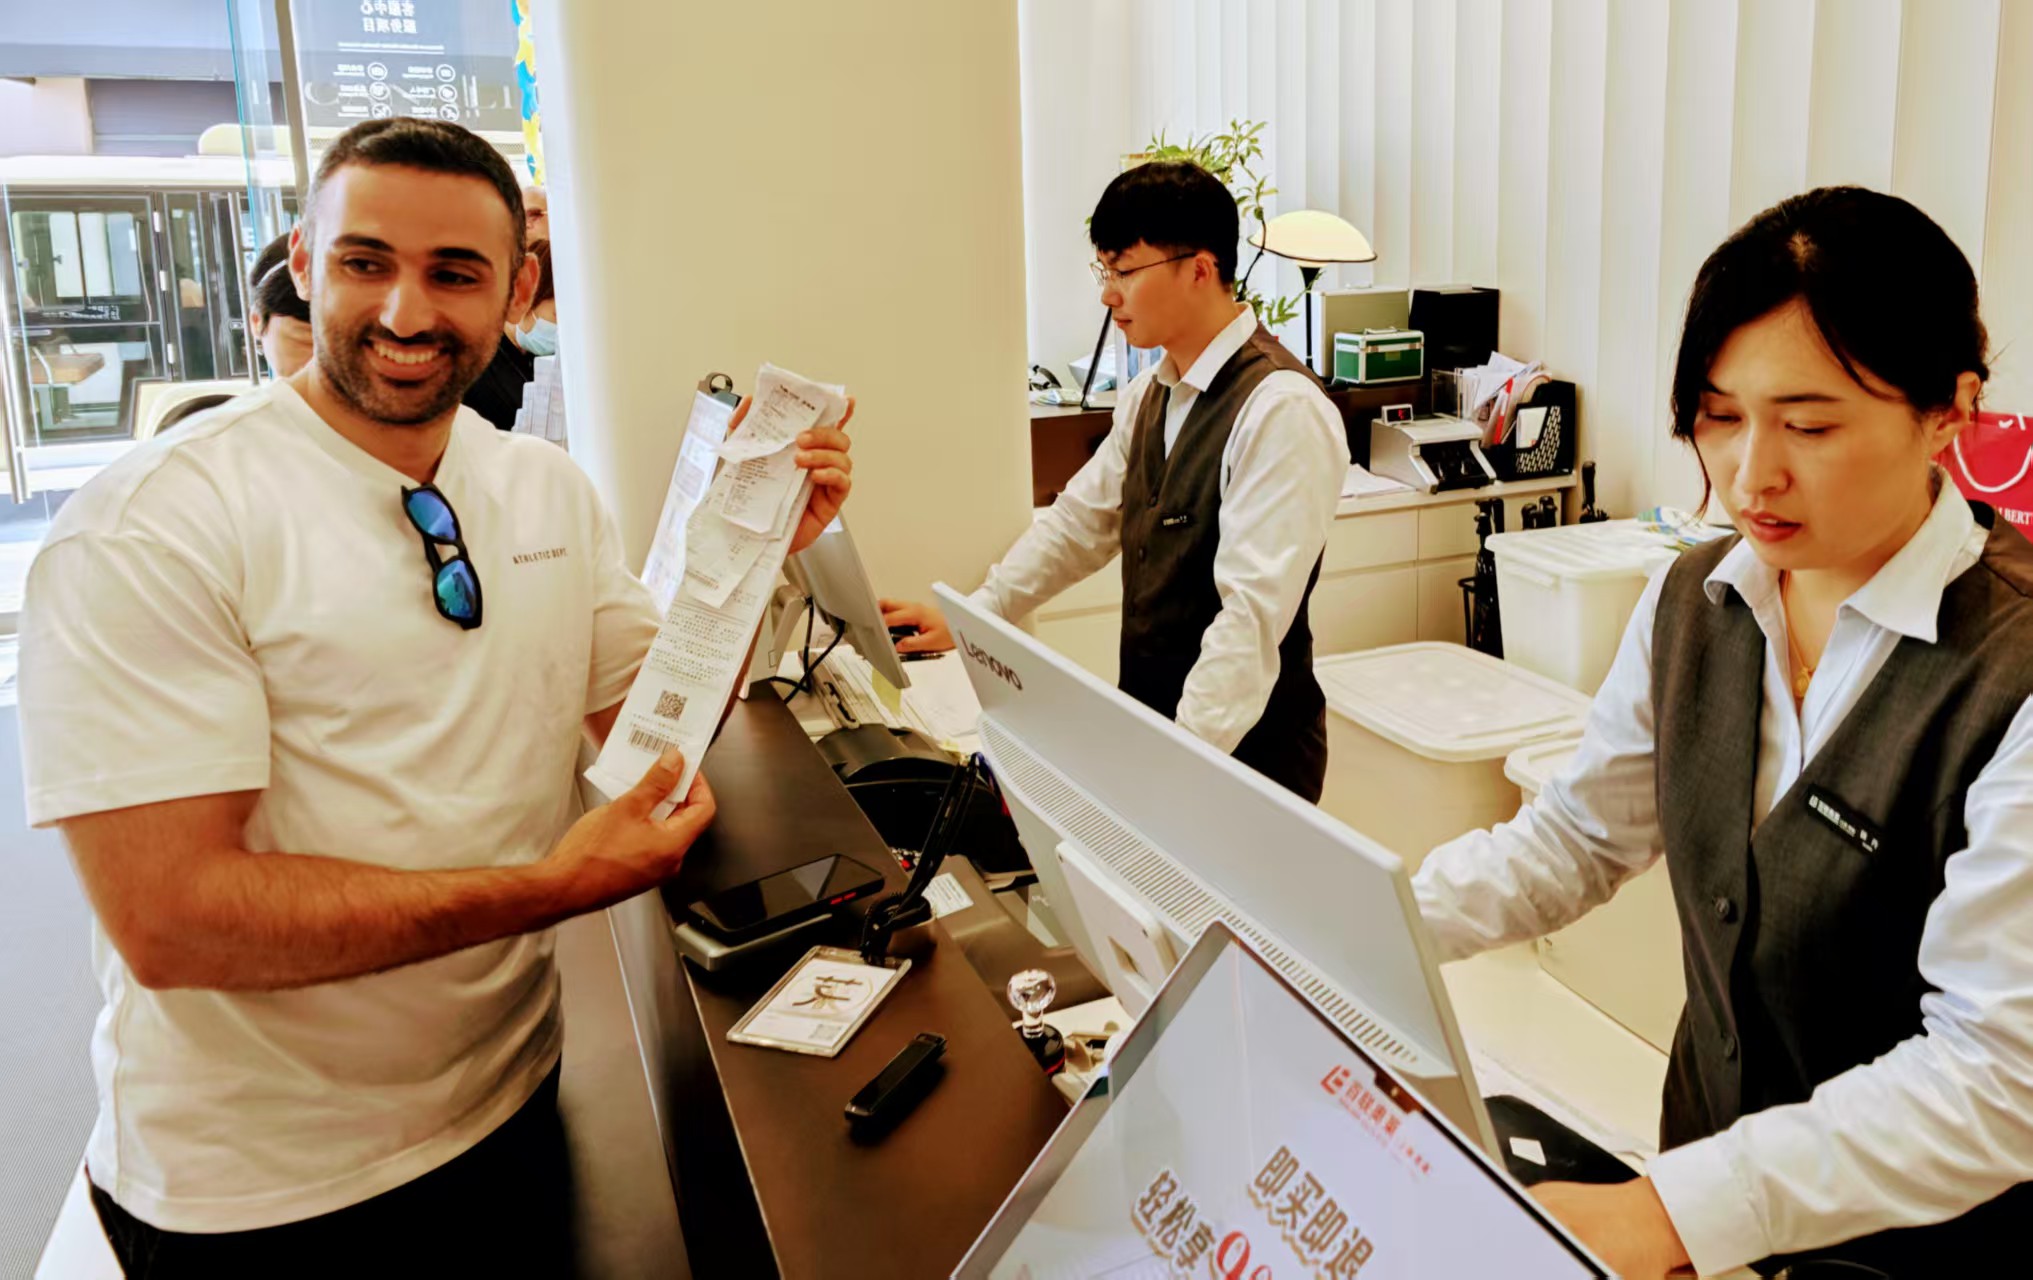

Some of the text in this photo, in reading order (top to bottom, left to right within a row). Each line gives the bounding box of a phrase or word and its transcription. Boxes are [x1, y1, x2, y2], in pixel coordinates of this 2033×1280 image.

[957, 629, 1023, 691] Lenovo
[1254, 1145, 1374, 1280] 即买即退
